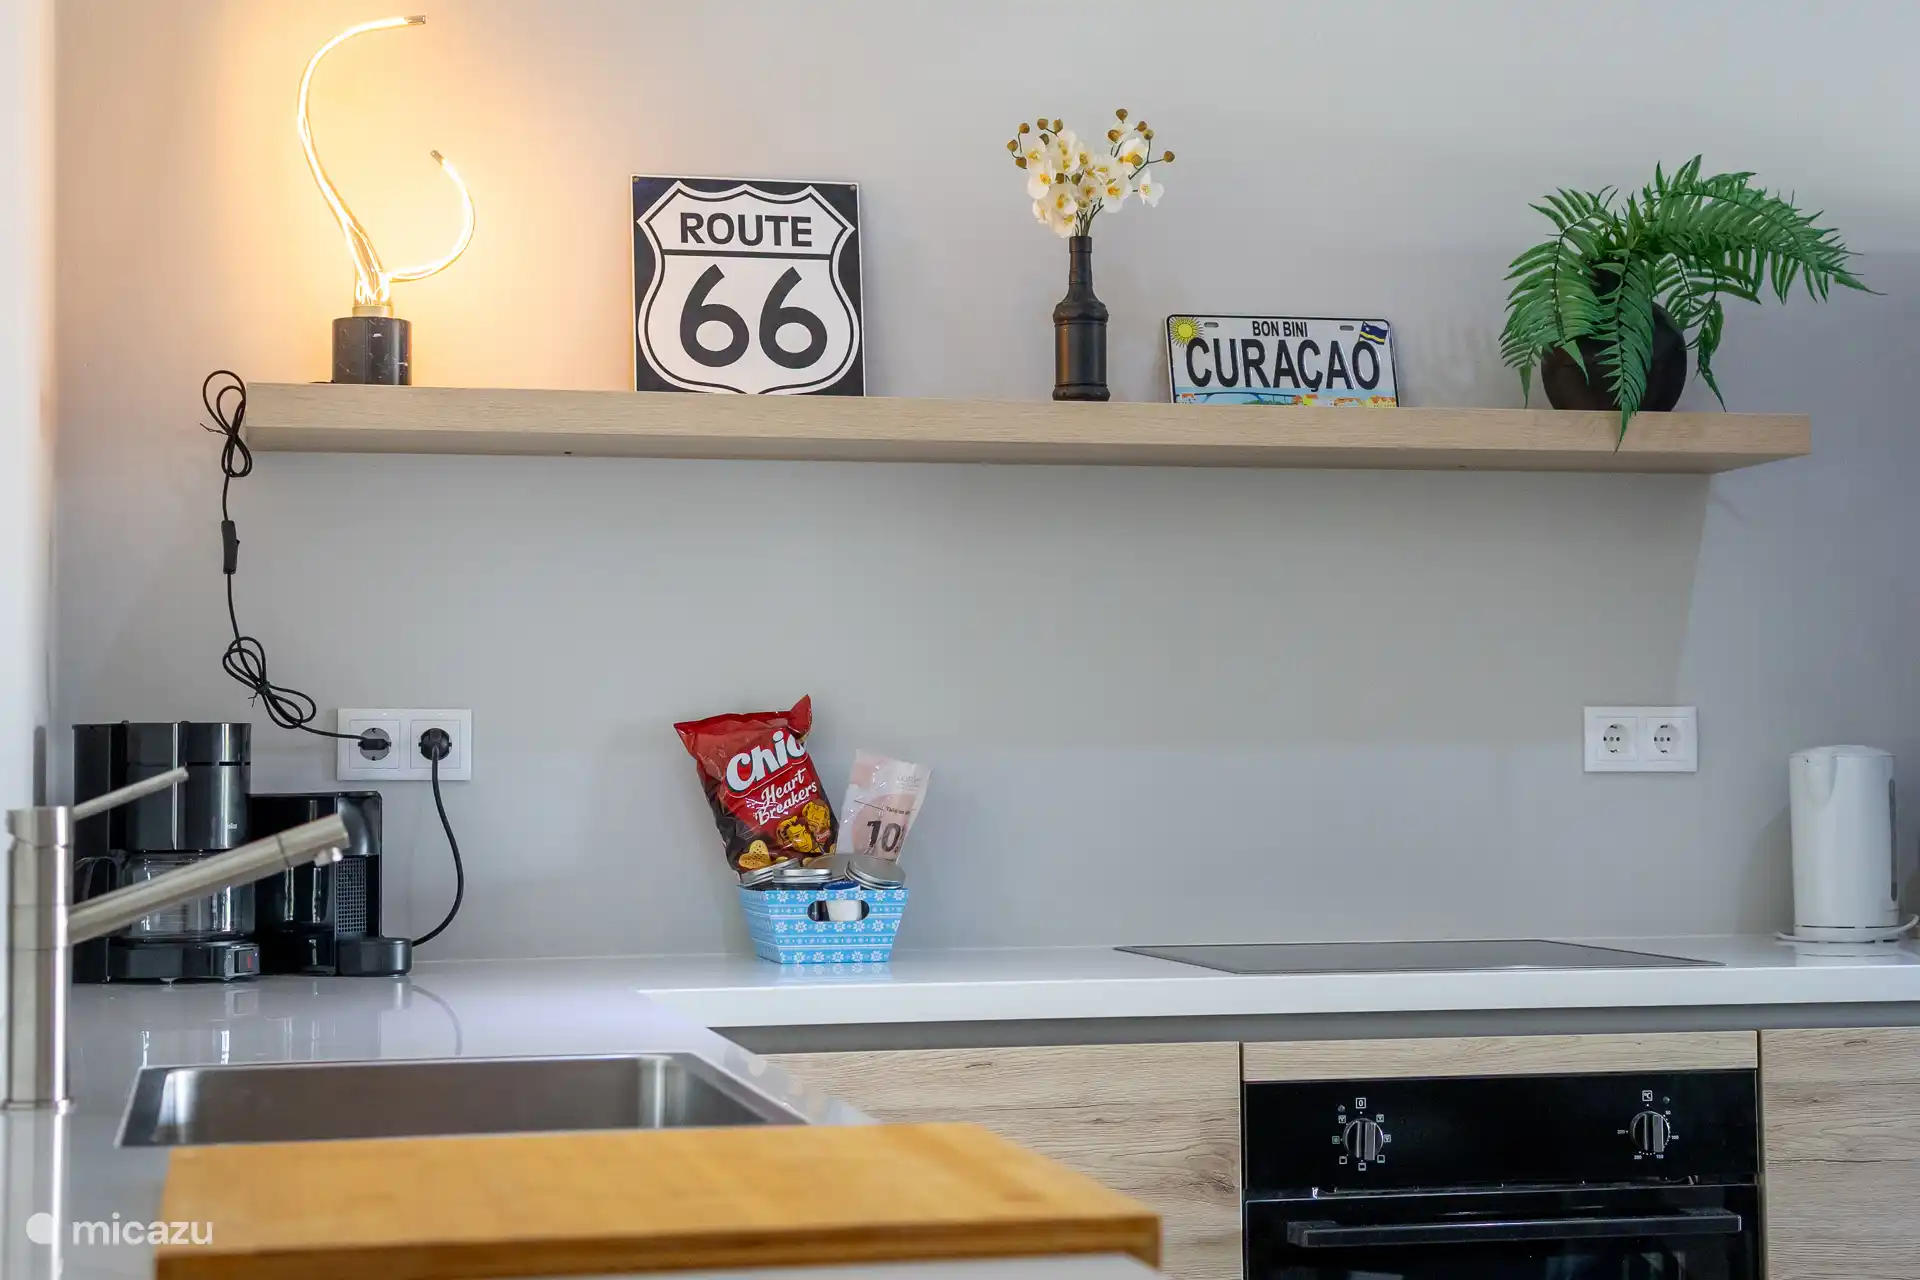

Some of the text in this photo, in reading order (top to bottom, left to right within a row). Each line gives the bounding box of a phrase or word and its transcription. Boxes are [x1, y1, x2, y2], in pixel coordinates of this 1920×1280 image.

[680, 212, 812, 247] ROUTE
[680, 263, 827, 369] 66
[1252, 320, 1308, 338] BON BINI
[1186, 337, 1380, 392] CURAÇAO
[756, 781, 817, 826] Breakers
[761, 767, 806, 804] Heart
